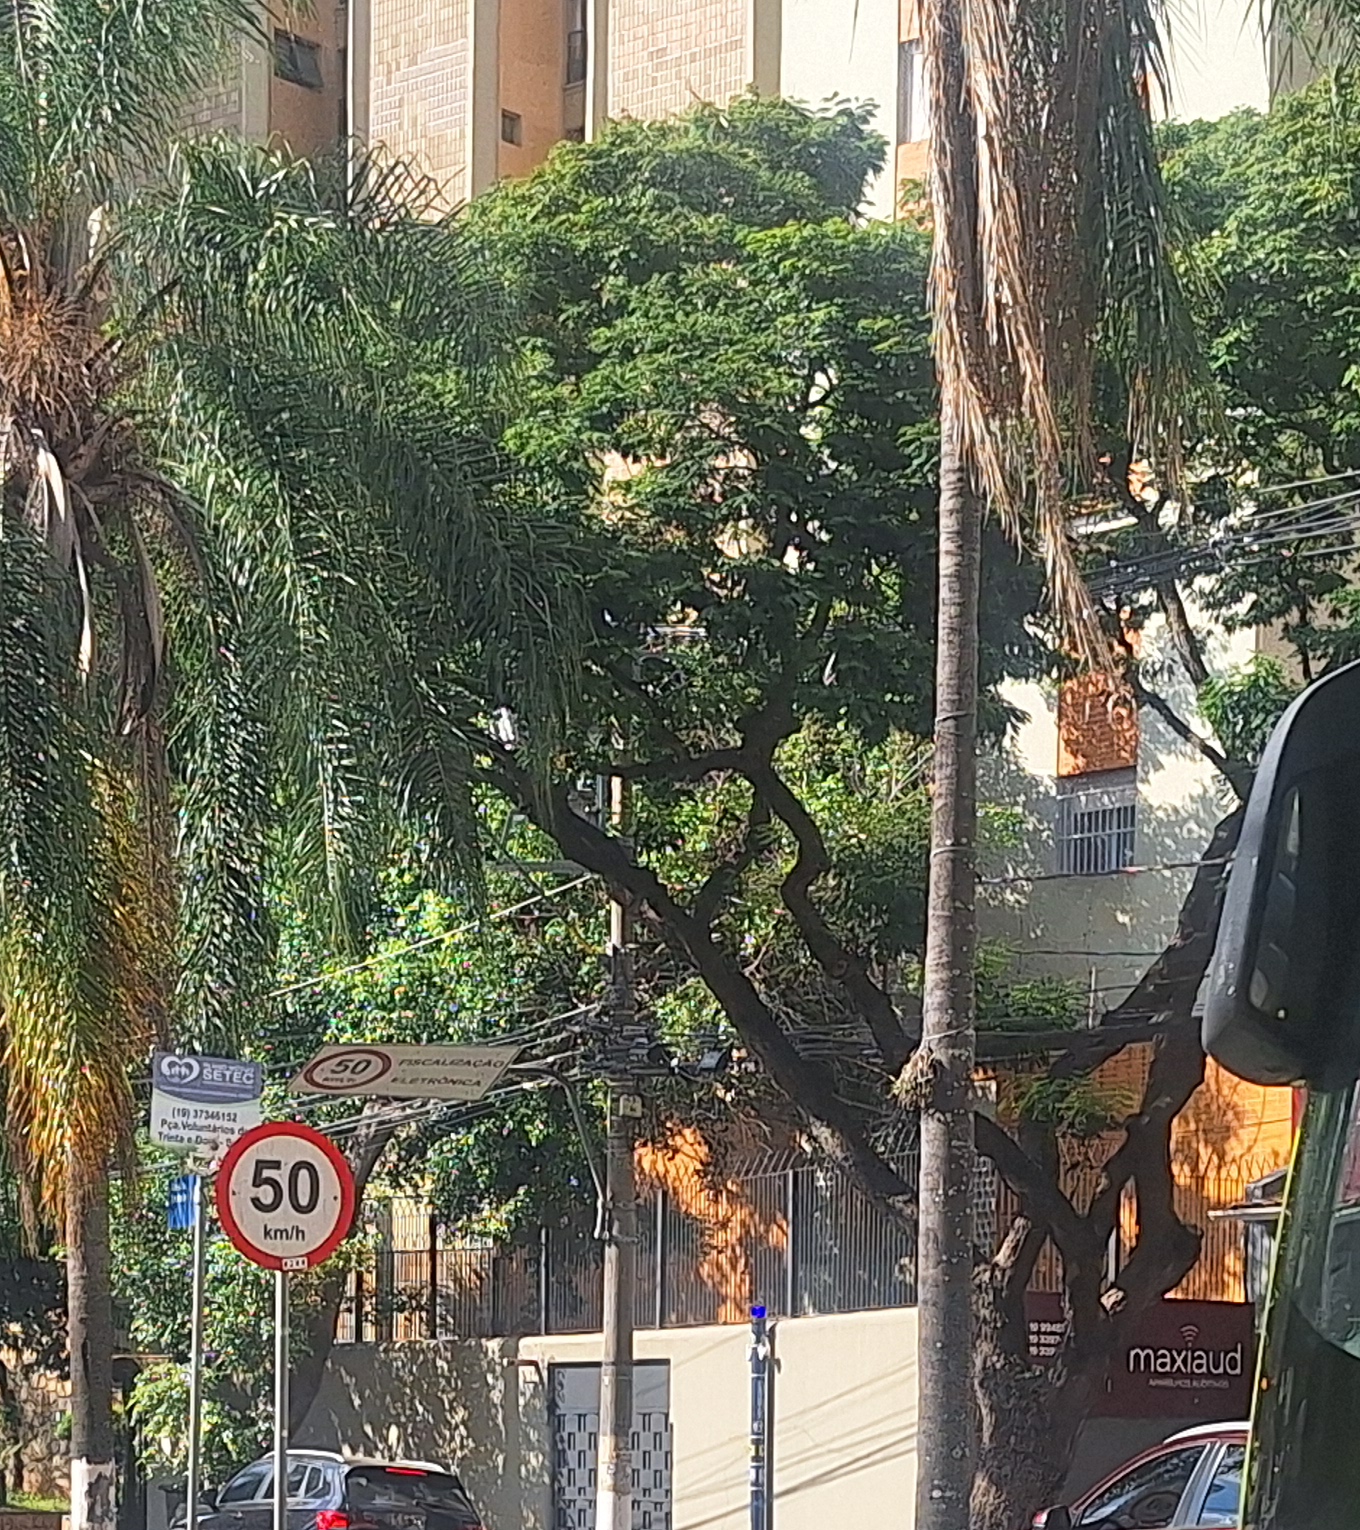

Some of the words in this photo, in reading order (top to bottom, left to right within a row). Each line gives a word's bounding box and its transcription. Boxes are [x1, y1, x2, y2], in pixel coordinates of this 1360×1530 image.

[330, 1058, 372, 1075] 50
[398, 1057, 505, 1068] FISCALIZAÇÃO
[202, 1068, 254, 1085] SETEC
[391, 1075, 482, 1087] ELETRÔNICA
[250, 1159, 320, 1215] 50
[264, 1224, 306, 1242] km/h
[1128, 1342, 1242, 1375] maxiaud
